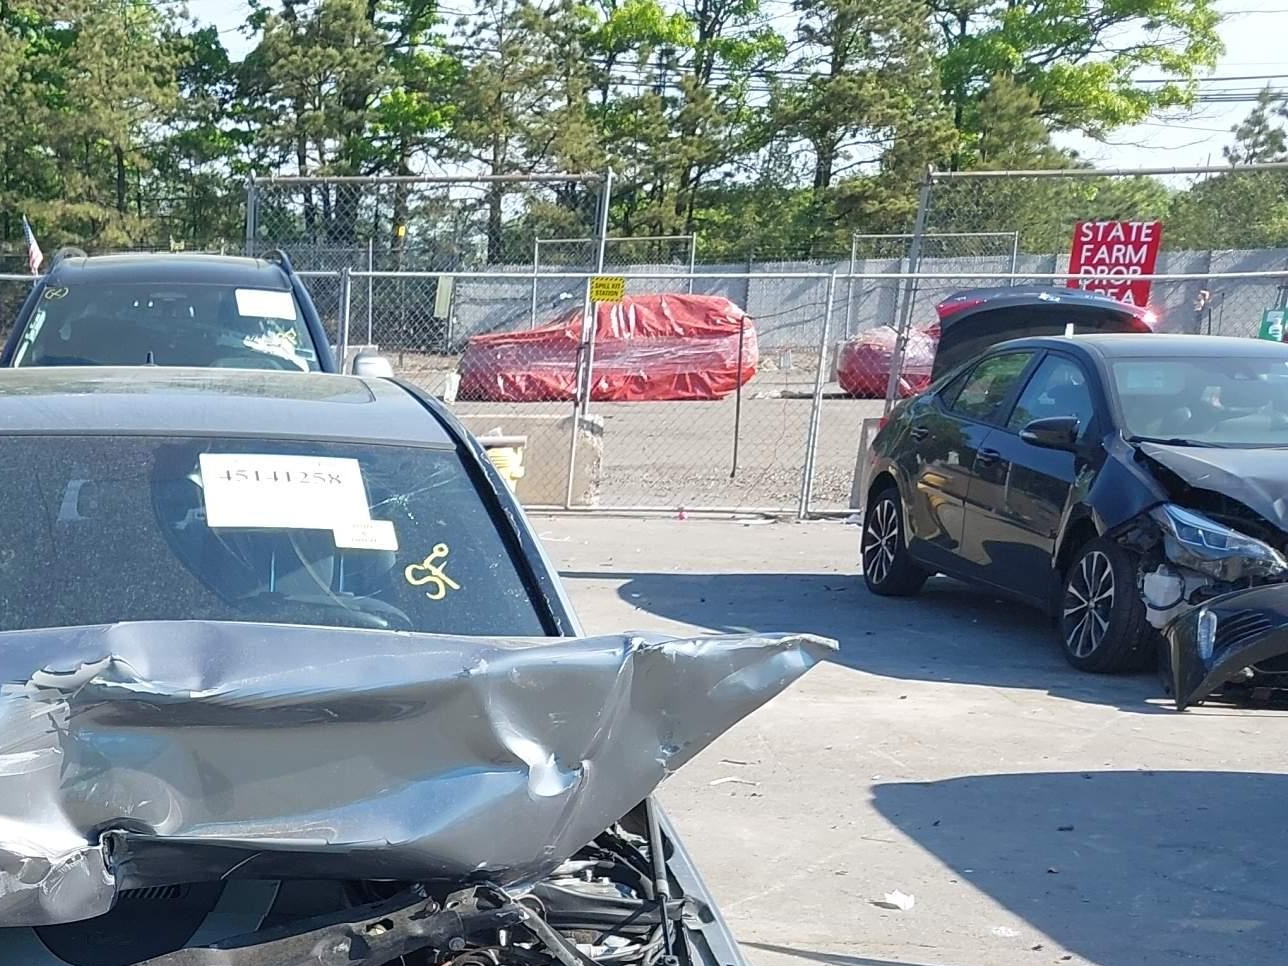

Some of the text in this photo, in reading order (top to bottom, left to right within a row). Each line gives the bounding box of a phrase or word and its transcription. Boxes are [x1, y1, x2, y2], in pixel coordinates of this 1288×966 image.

[1080, 222, 1154, 241] STATE
[1080, 244, 1148, 264] FARM
[1079, 265, 1142, 285] DROP
[219, 469, 342, 485] 45141258
